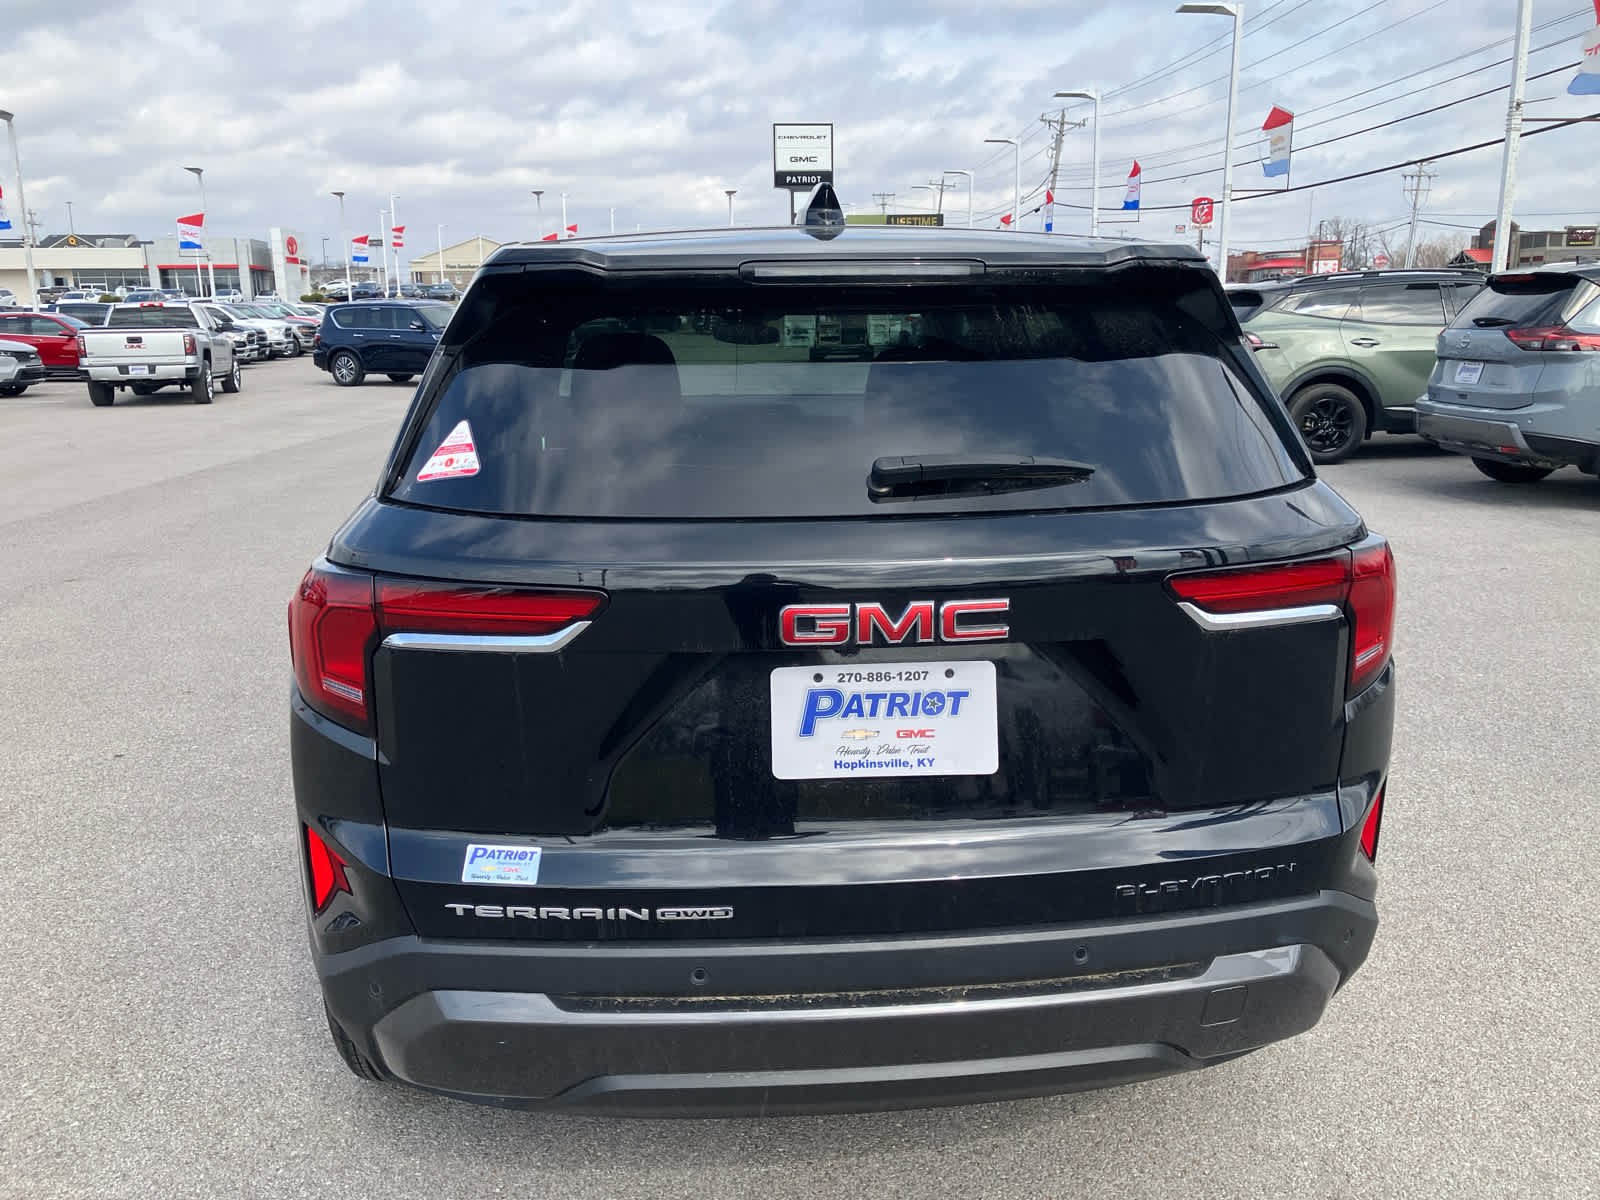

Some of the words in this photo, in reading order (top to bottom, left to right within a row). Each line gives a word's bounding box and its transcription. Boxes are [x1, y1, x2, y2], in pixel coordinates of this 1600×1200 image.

[785, 175, 822, 184] PATRIOT
[780, 597, 1011, 647] GMC
[836, 670, 930, 684] 270-886-1207
[798, 687, 970, 738] PATRIOT
[895, 728, 936, 739] GMC
[833, 759, 914, 772] Hopkinsville,
[916, 757, 936, 768] KY
[468, 847, 539, 865] PATRIOT
[1115, 862, 1297, 897] ELEVATION
[444, 903, 650, 921] TERRAIN
[657, 907, 733, 920] AWD
